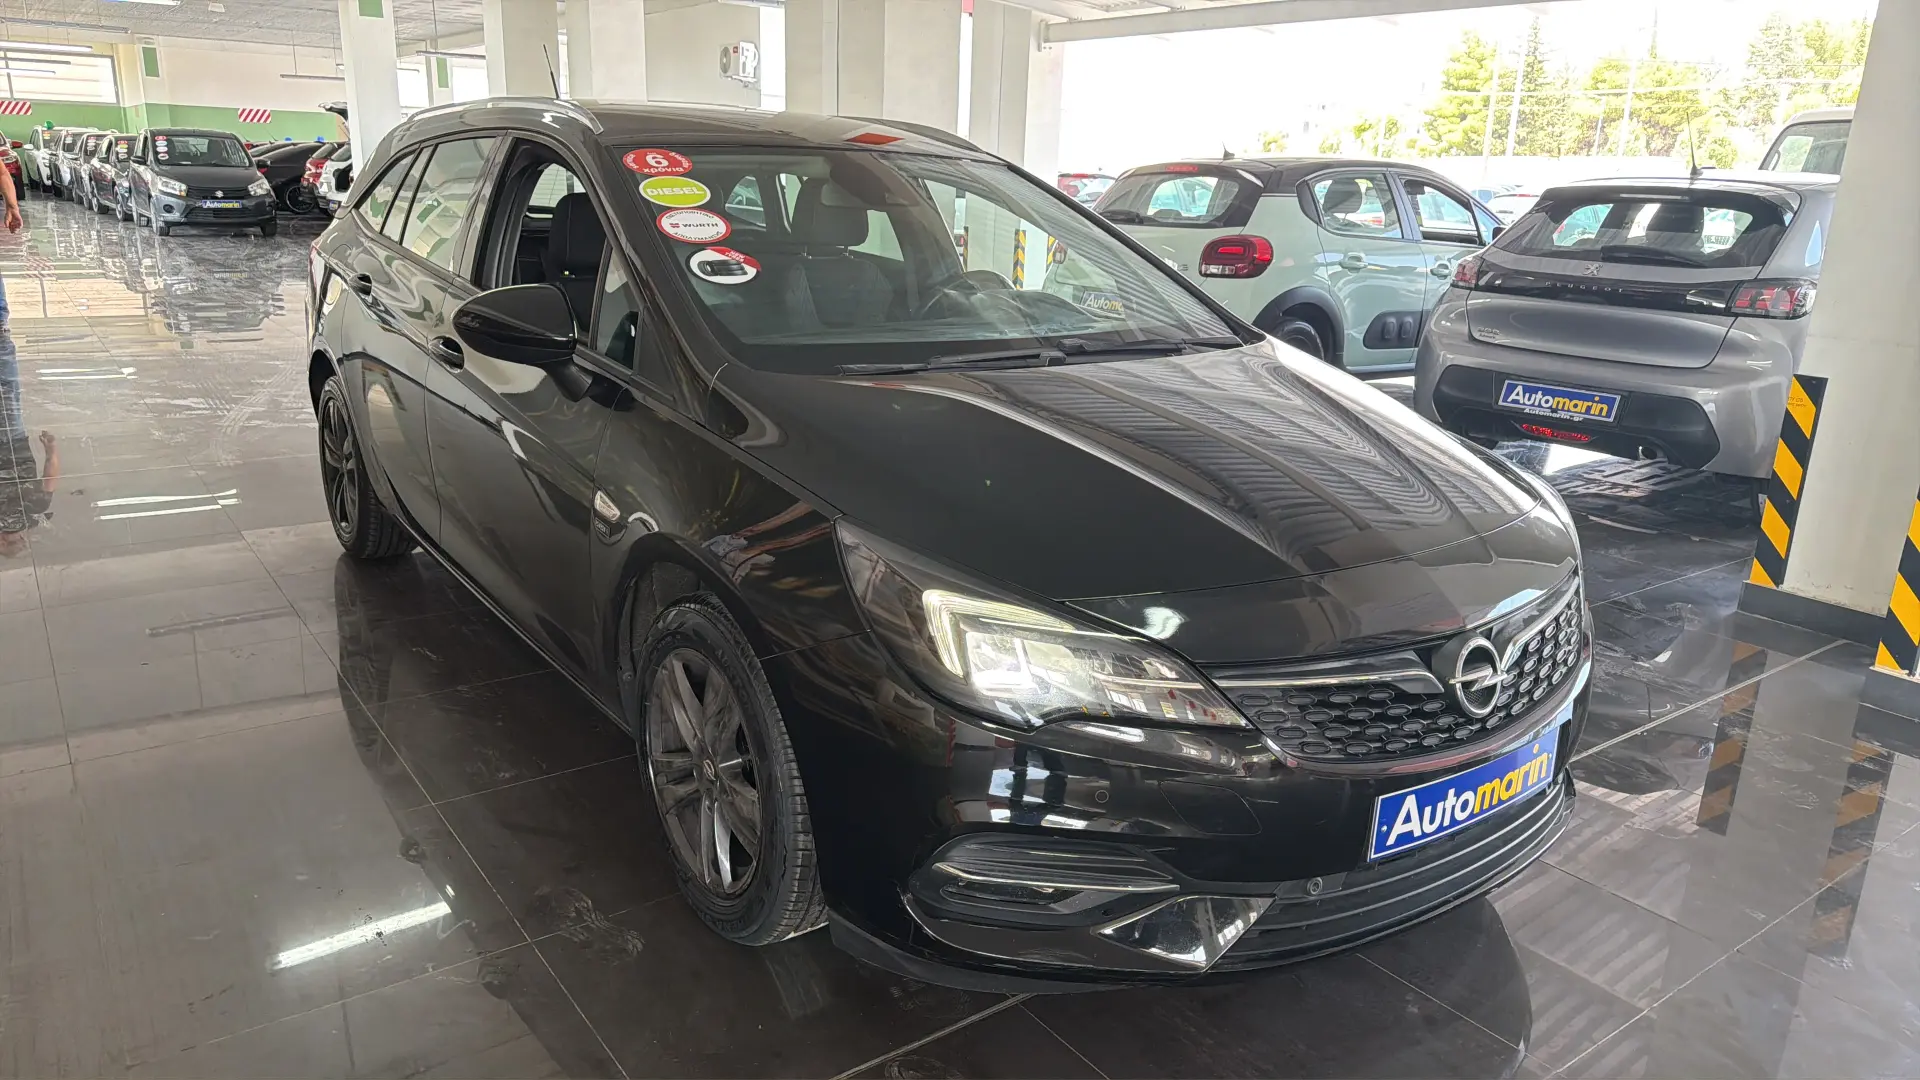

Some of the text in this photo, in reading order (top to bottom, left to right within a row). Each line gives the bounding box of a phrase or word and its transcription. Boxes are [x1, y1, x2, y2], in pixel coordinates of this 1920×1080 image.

[646, 154, 669, 167] 6
[646, 187, 704, 196] DIESEL
[1545, 281, 1623, 293] PEUGEOT
[1507, 385, 1608, 416] Automarin
[1523, 408, 1584, 422] Automarin.gr
[1385, 743, 1549, 847] Automarin
